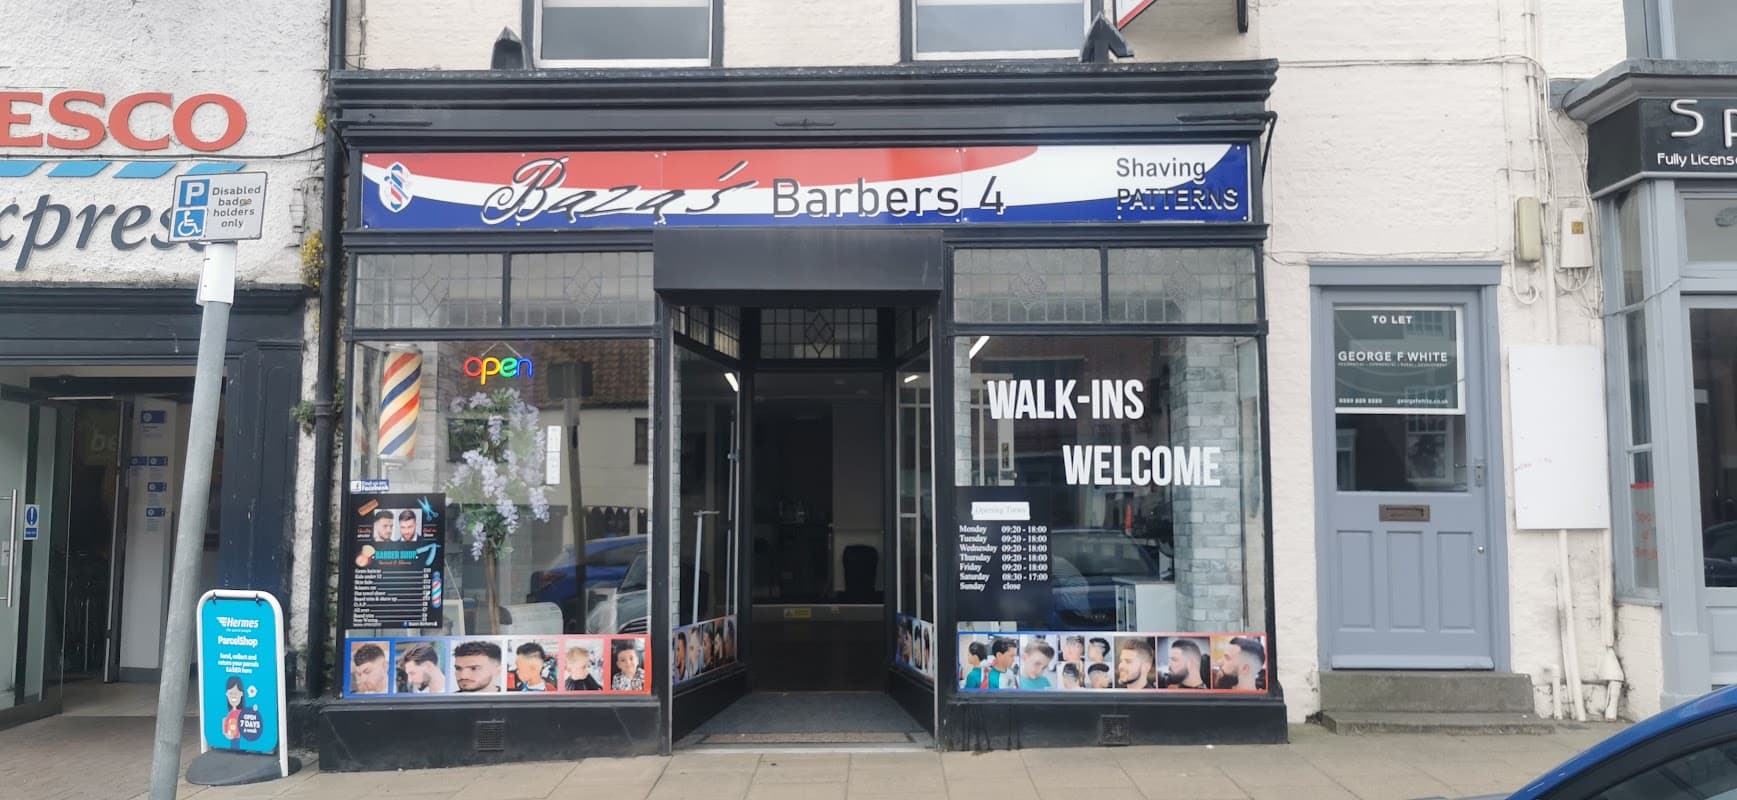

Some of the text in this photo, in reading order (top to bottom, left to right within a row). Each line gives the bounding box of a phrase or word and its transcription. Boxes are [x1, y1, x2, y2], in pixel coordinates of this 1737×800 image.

[1657, 152, 1737, 168] Fully Licens
[1116, 157, 1206, 185] Shaving
[185, 182, 205, 205] P
[212, 185, 261, 196] Disabled
[772, 177, 960, 218] Barbers
[979, 175, 1004, 215] 4
[1117, 188, 1239, 211] PATTERNS
[213, 208, 255, 217] holders
[221, 218, 244, 229] only
[1371, 315, 1413, 325] TO LET
[1338, 351, 1448, 362] GEORGE F WHITE
[463, 356, 534, 385] open
[987, 379, 1145, 420] WALK-INS
[1062, 444, 1222, 487] WELCOME
[959, 525, 987, 534] Monday
[959, 534, 987, 544] Tuesday
[959, 544, 998, 553] Wednesday
[960, 553, 991, 563] Thursday
[960, 563, 982, 572] Friday
[960, 572, 990, 582] Saturday
[960, 582, 1021, 591] Sunday close
[227, 617, 259, 628] Hermes
[217, 635, 258, 648] ParcelShop
[240, 719, 260, 728] 7 DAYS
